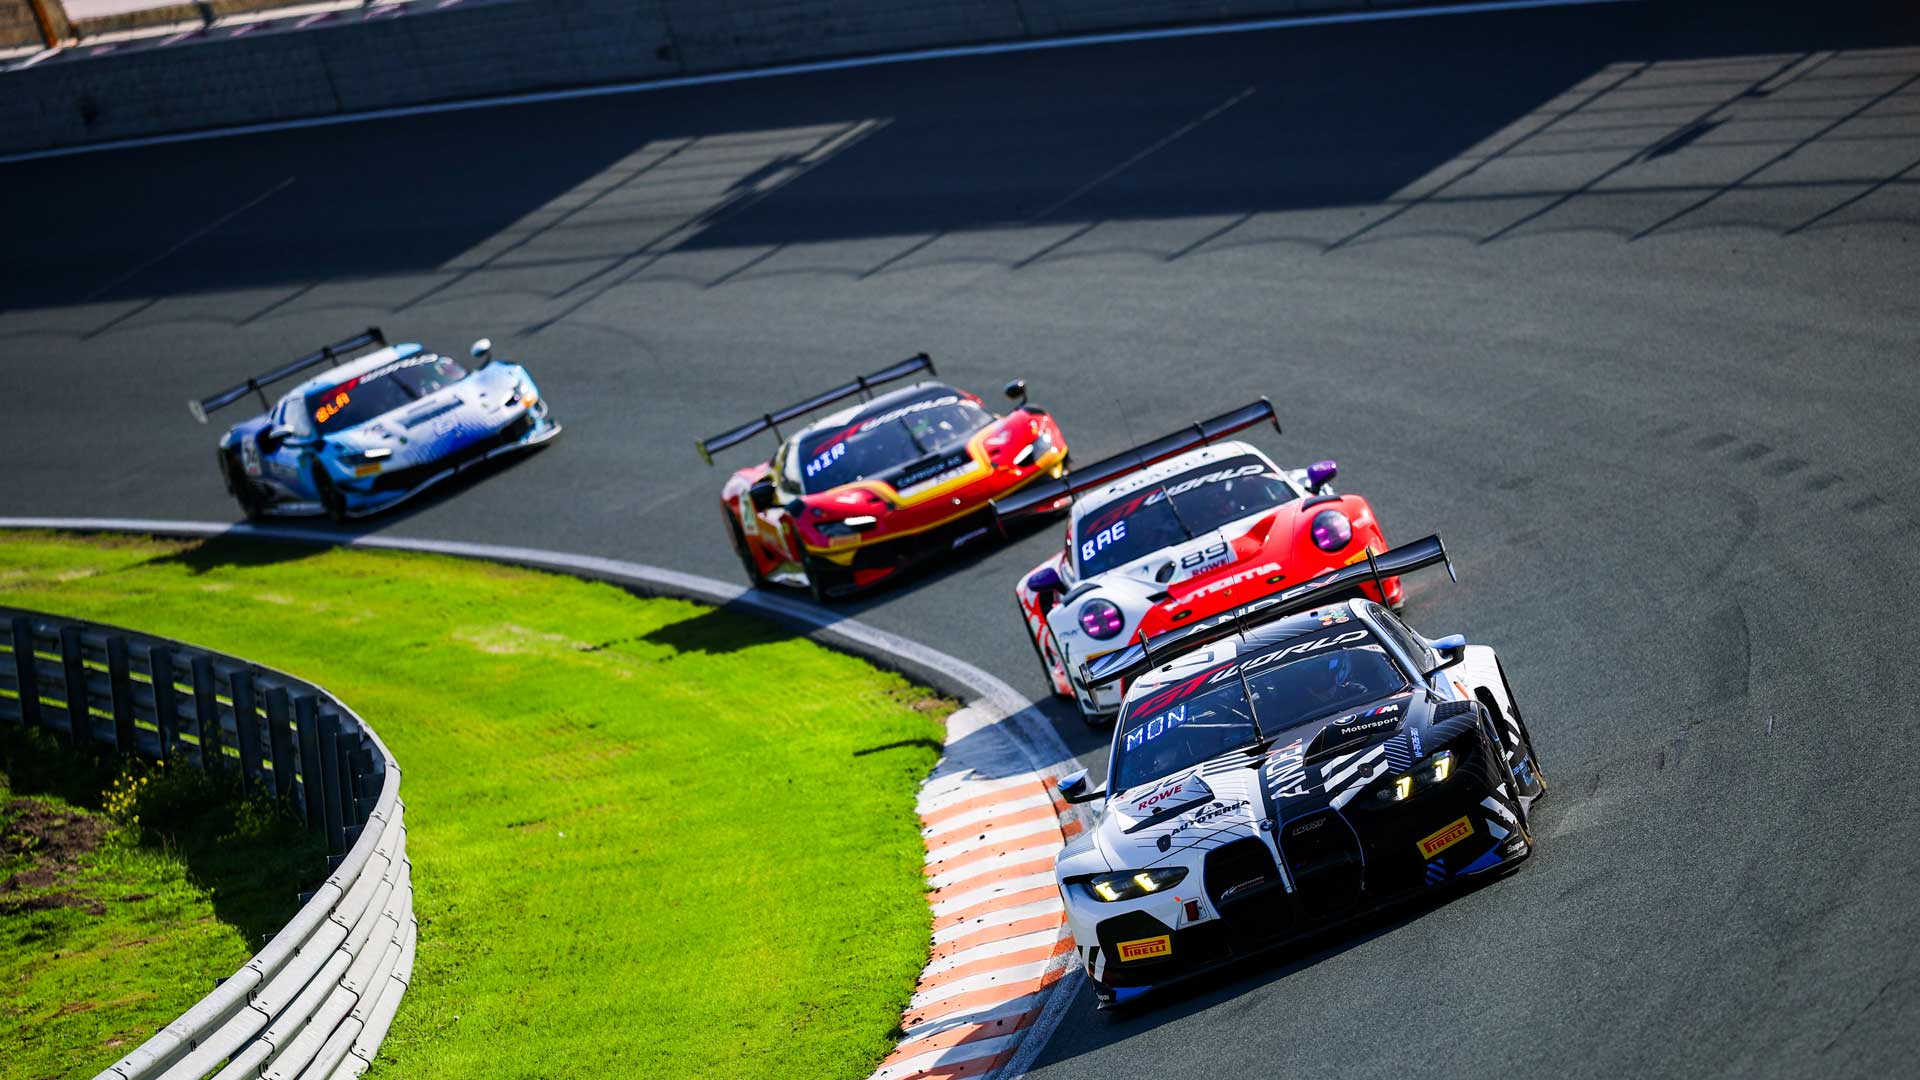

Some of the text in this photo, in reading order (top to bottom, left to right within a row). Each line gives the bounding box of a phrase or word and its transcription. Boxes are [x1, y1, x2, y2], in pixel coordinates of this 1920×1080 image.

[1081, 520, 1127, 561] BAE
[1180, 541, 1228, 569] 89
[1206, 629, 1369, 685] WORLD
[1126, 704, 1187, 752] MON
[1341, 716, 1399, 735] Motorsport
[1138, 784, 1182, 811] ROWE
[1170, 799, 1251, 836] AUTOTERRA
[1423, 821, 1469, 854] PIRELLI
[1121, 939, 1167, 958] PIRELLI
